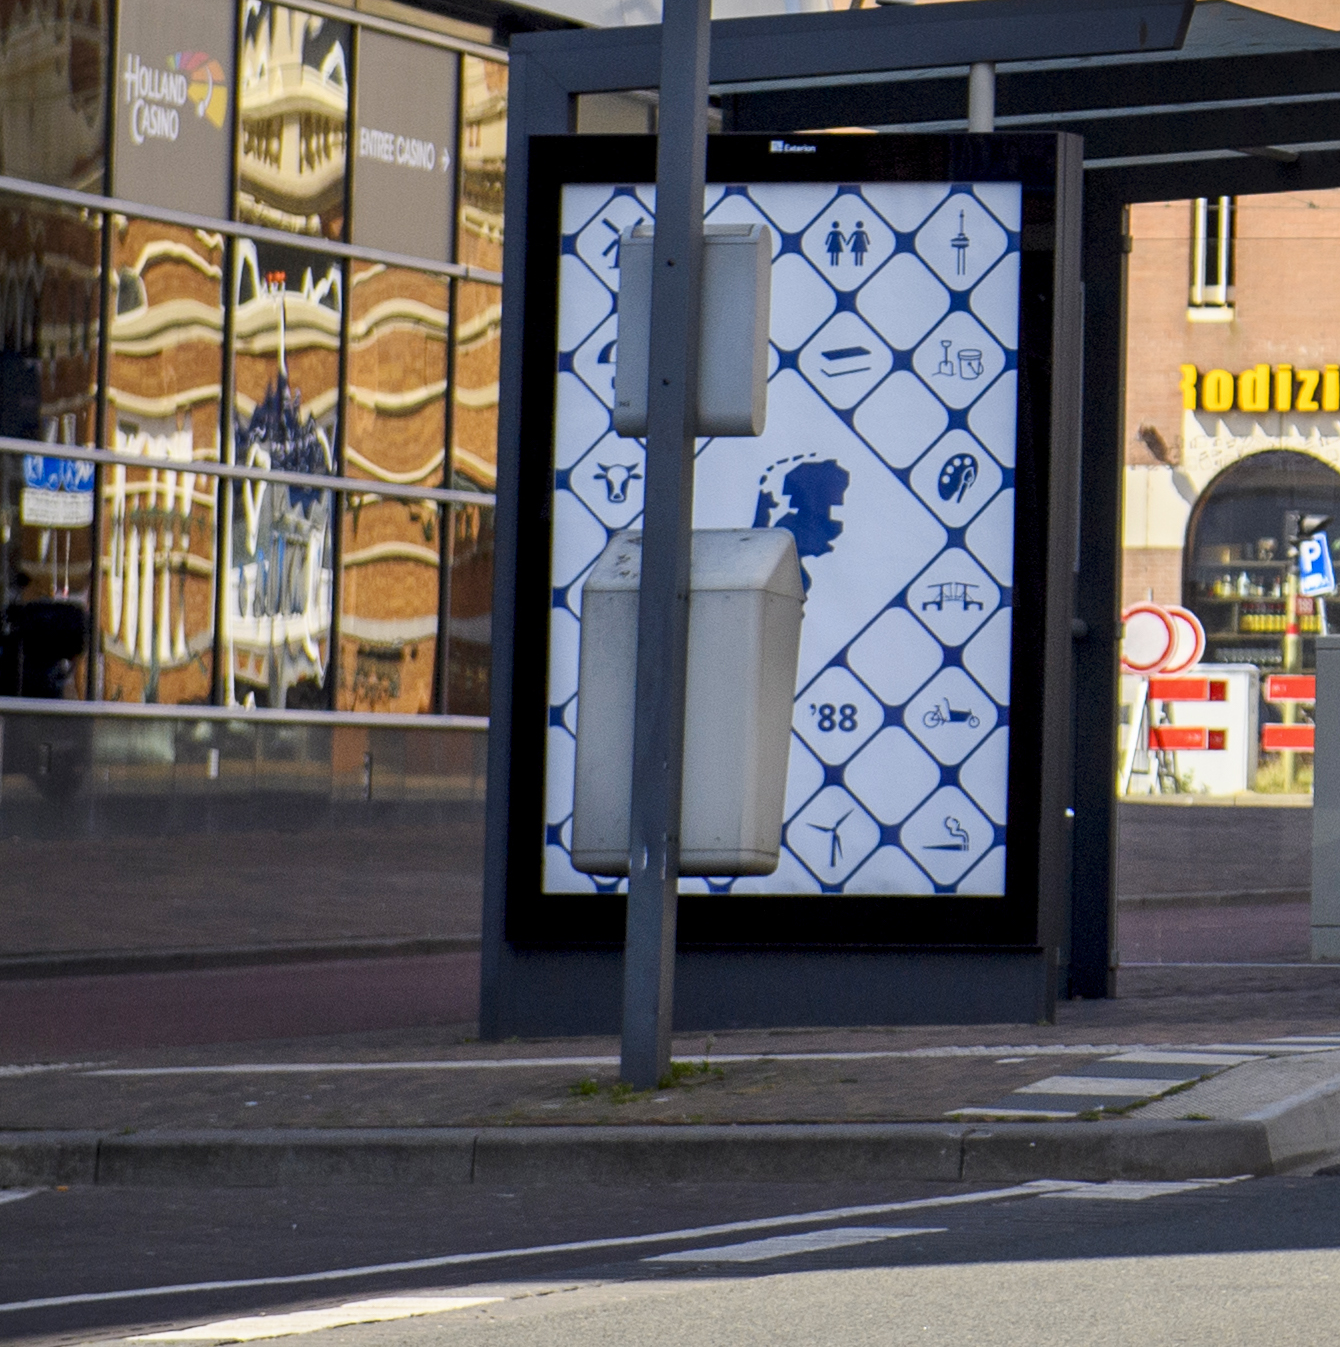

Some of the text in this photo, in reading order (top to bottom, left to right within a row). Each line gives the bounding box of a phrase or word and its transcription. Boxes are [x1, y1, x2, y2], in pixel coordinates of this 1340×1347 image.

[125, 53, 188, 106] HOLLAND
[132, 98, 180, 145] CASINO
[360, 126, 436, 172] ENTREE CASINO
